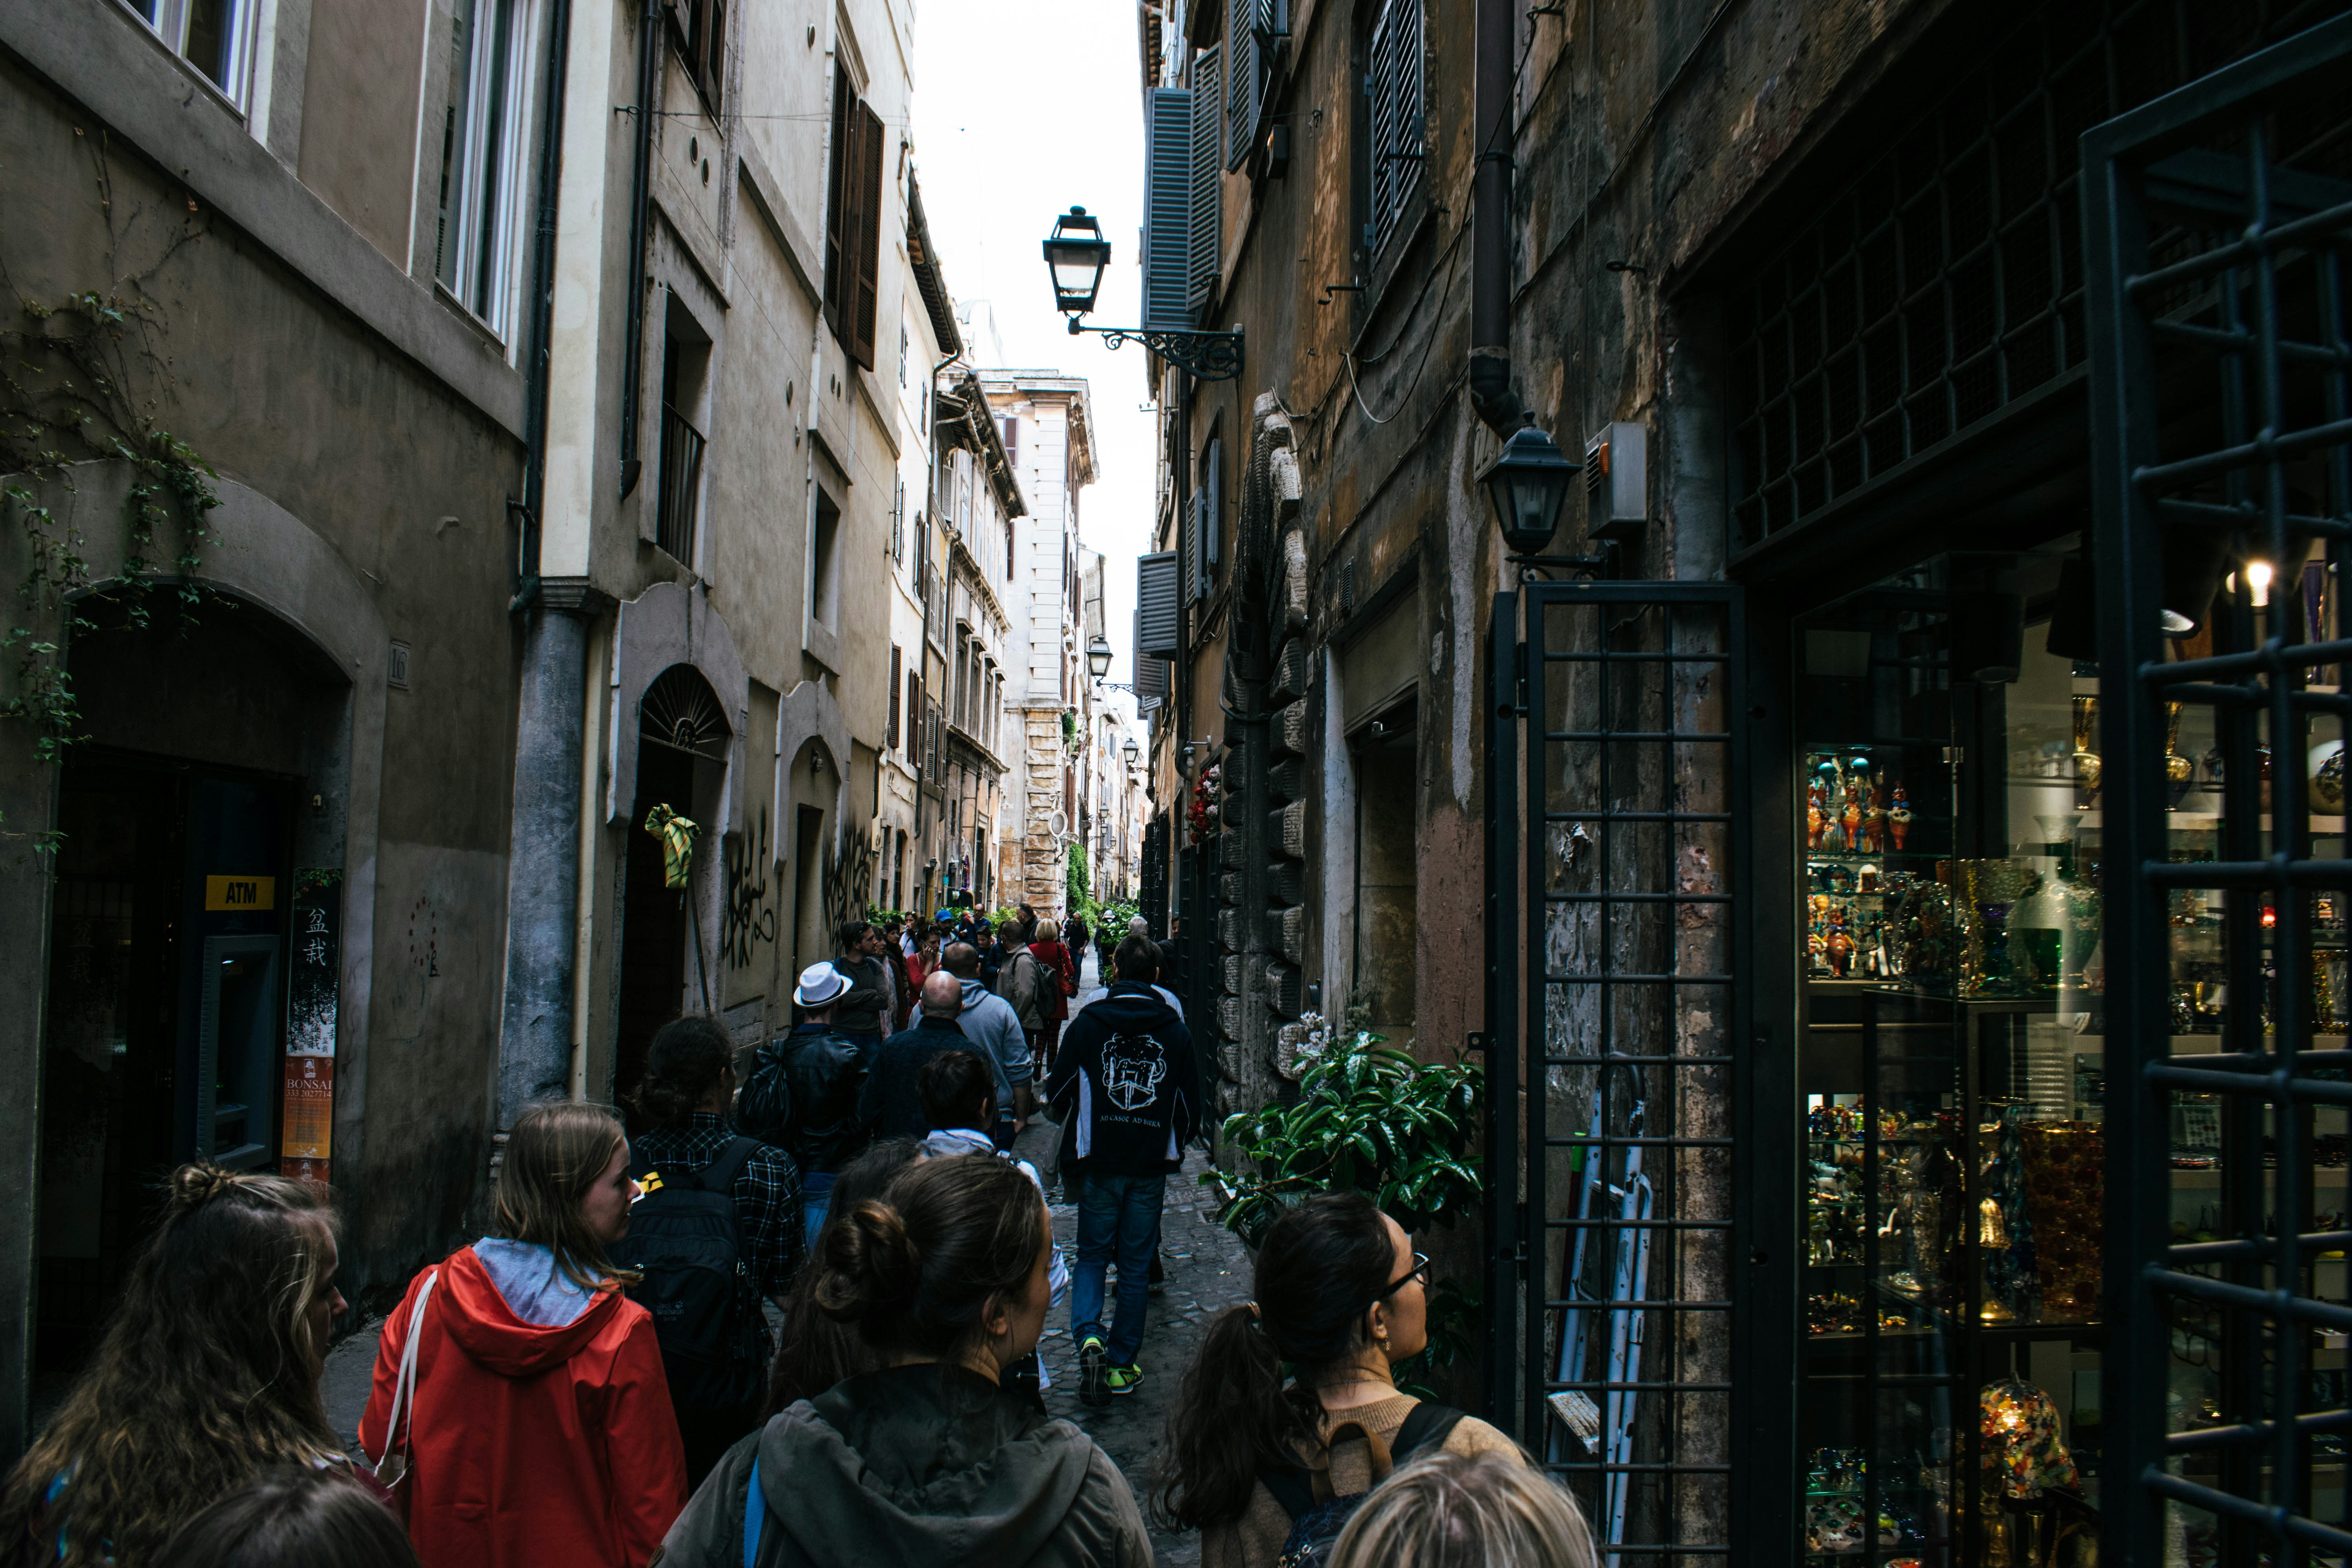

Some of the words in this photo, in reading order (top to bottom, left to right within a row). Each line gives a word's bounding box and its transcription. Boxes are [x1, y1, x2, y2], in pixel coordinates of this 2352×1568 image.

[392, 649, 407, 679] 16
[226, 882, 257, 904] ATM
[302, 908, 329, 966] 盆栽
[287, 1079, 332, 1089] BONSAI
